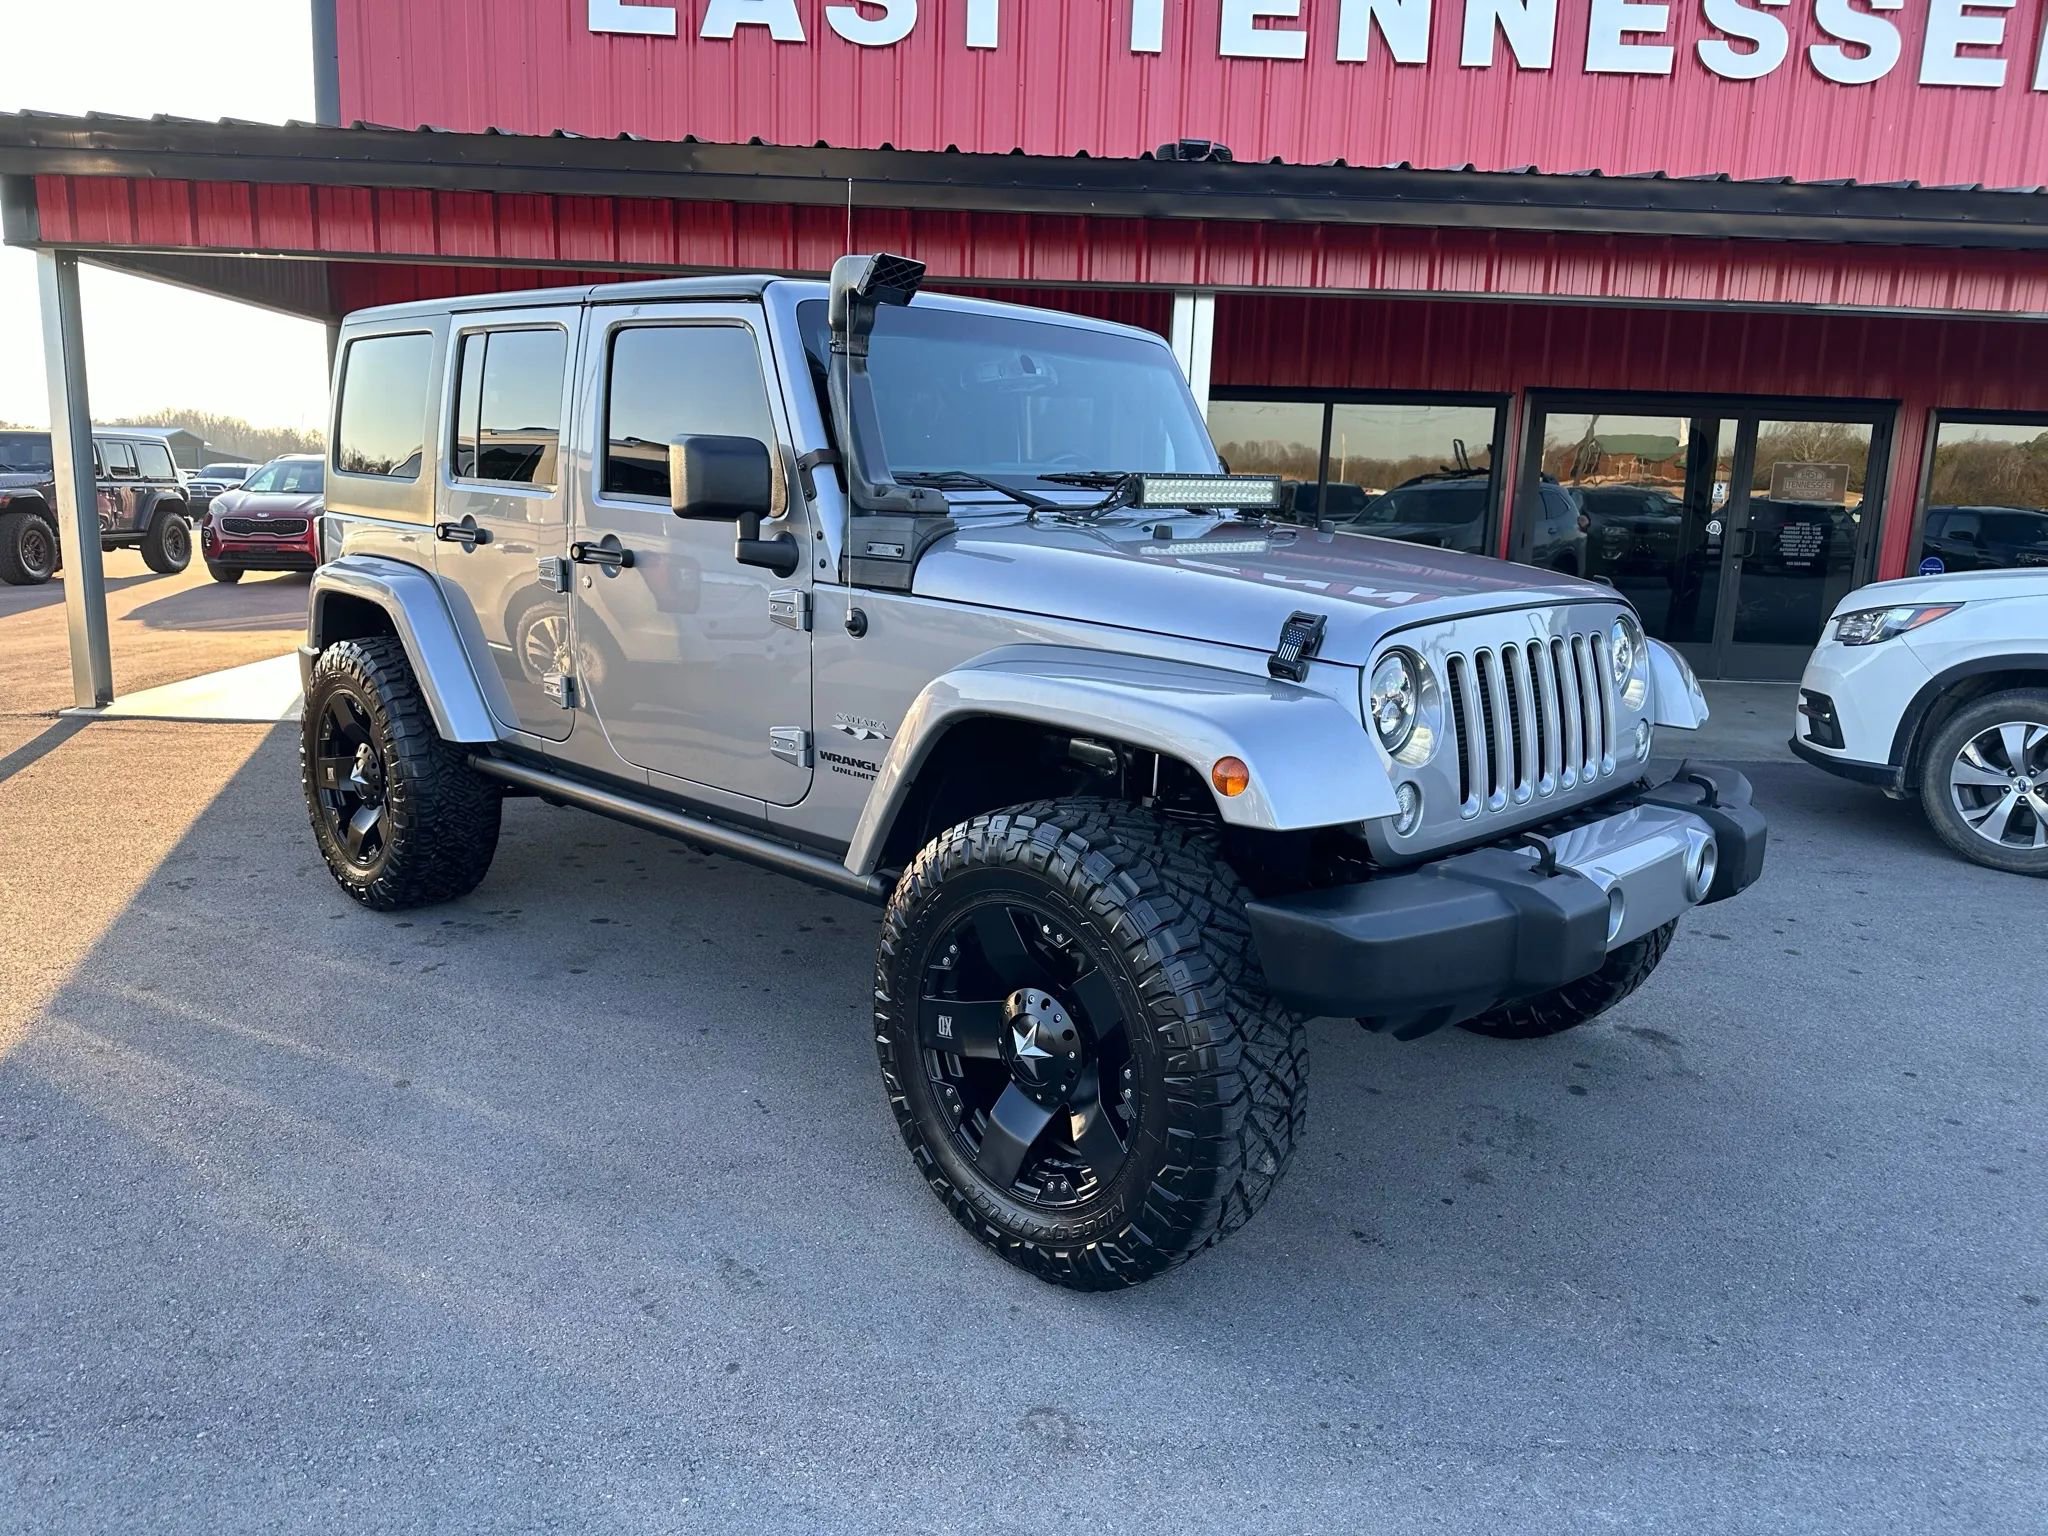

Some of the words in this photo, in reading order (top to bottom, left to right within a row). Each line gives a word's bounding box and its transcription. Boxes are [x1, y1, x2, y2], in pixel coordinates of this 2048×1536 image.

[1130, 0, 2048, 91] ENNESSE
[835, 712, 888, 731] SAHARA
[819, 750, 882, 773] WRANGL
